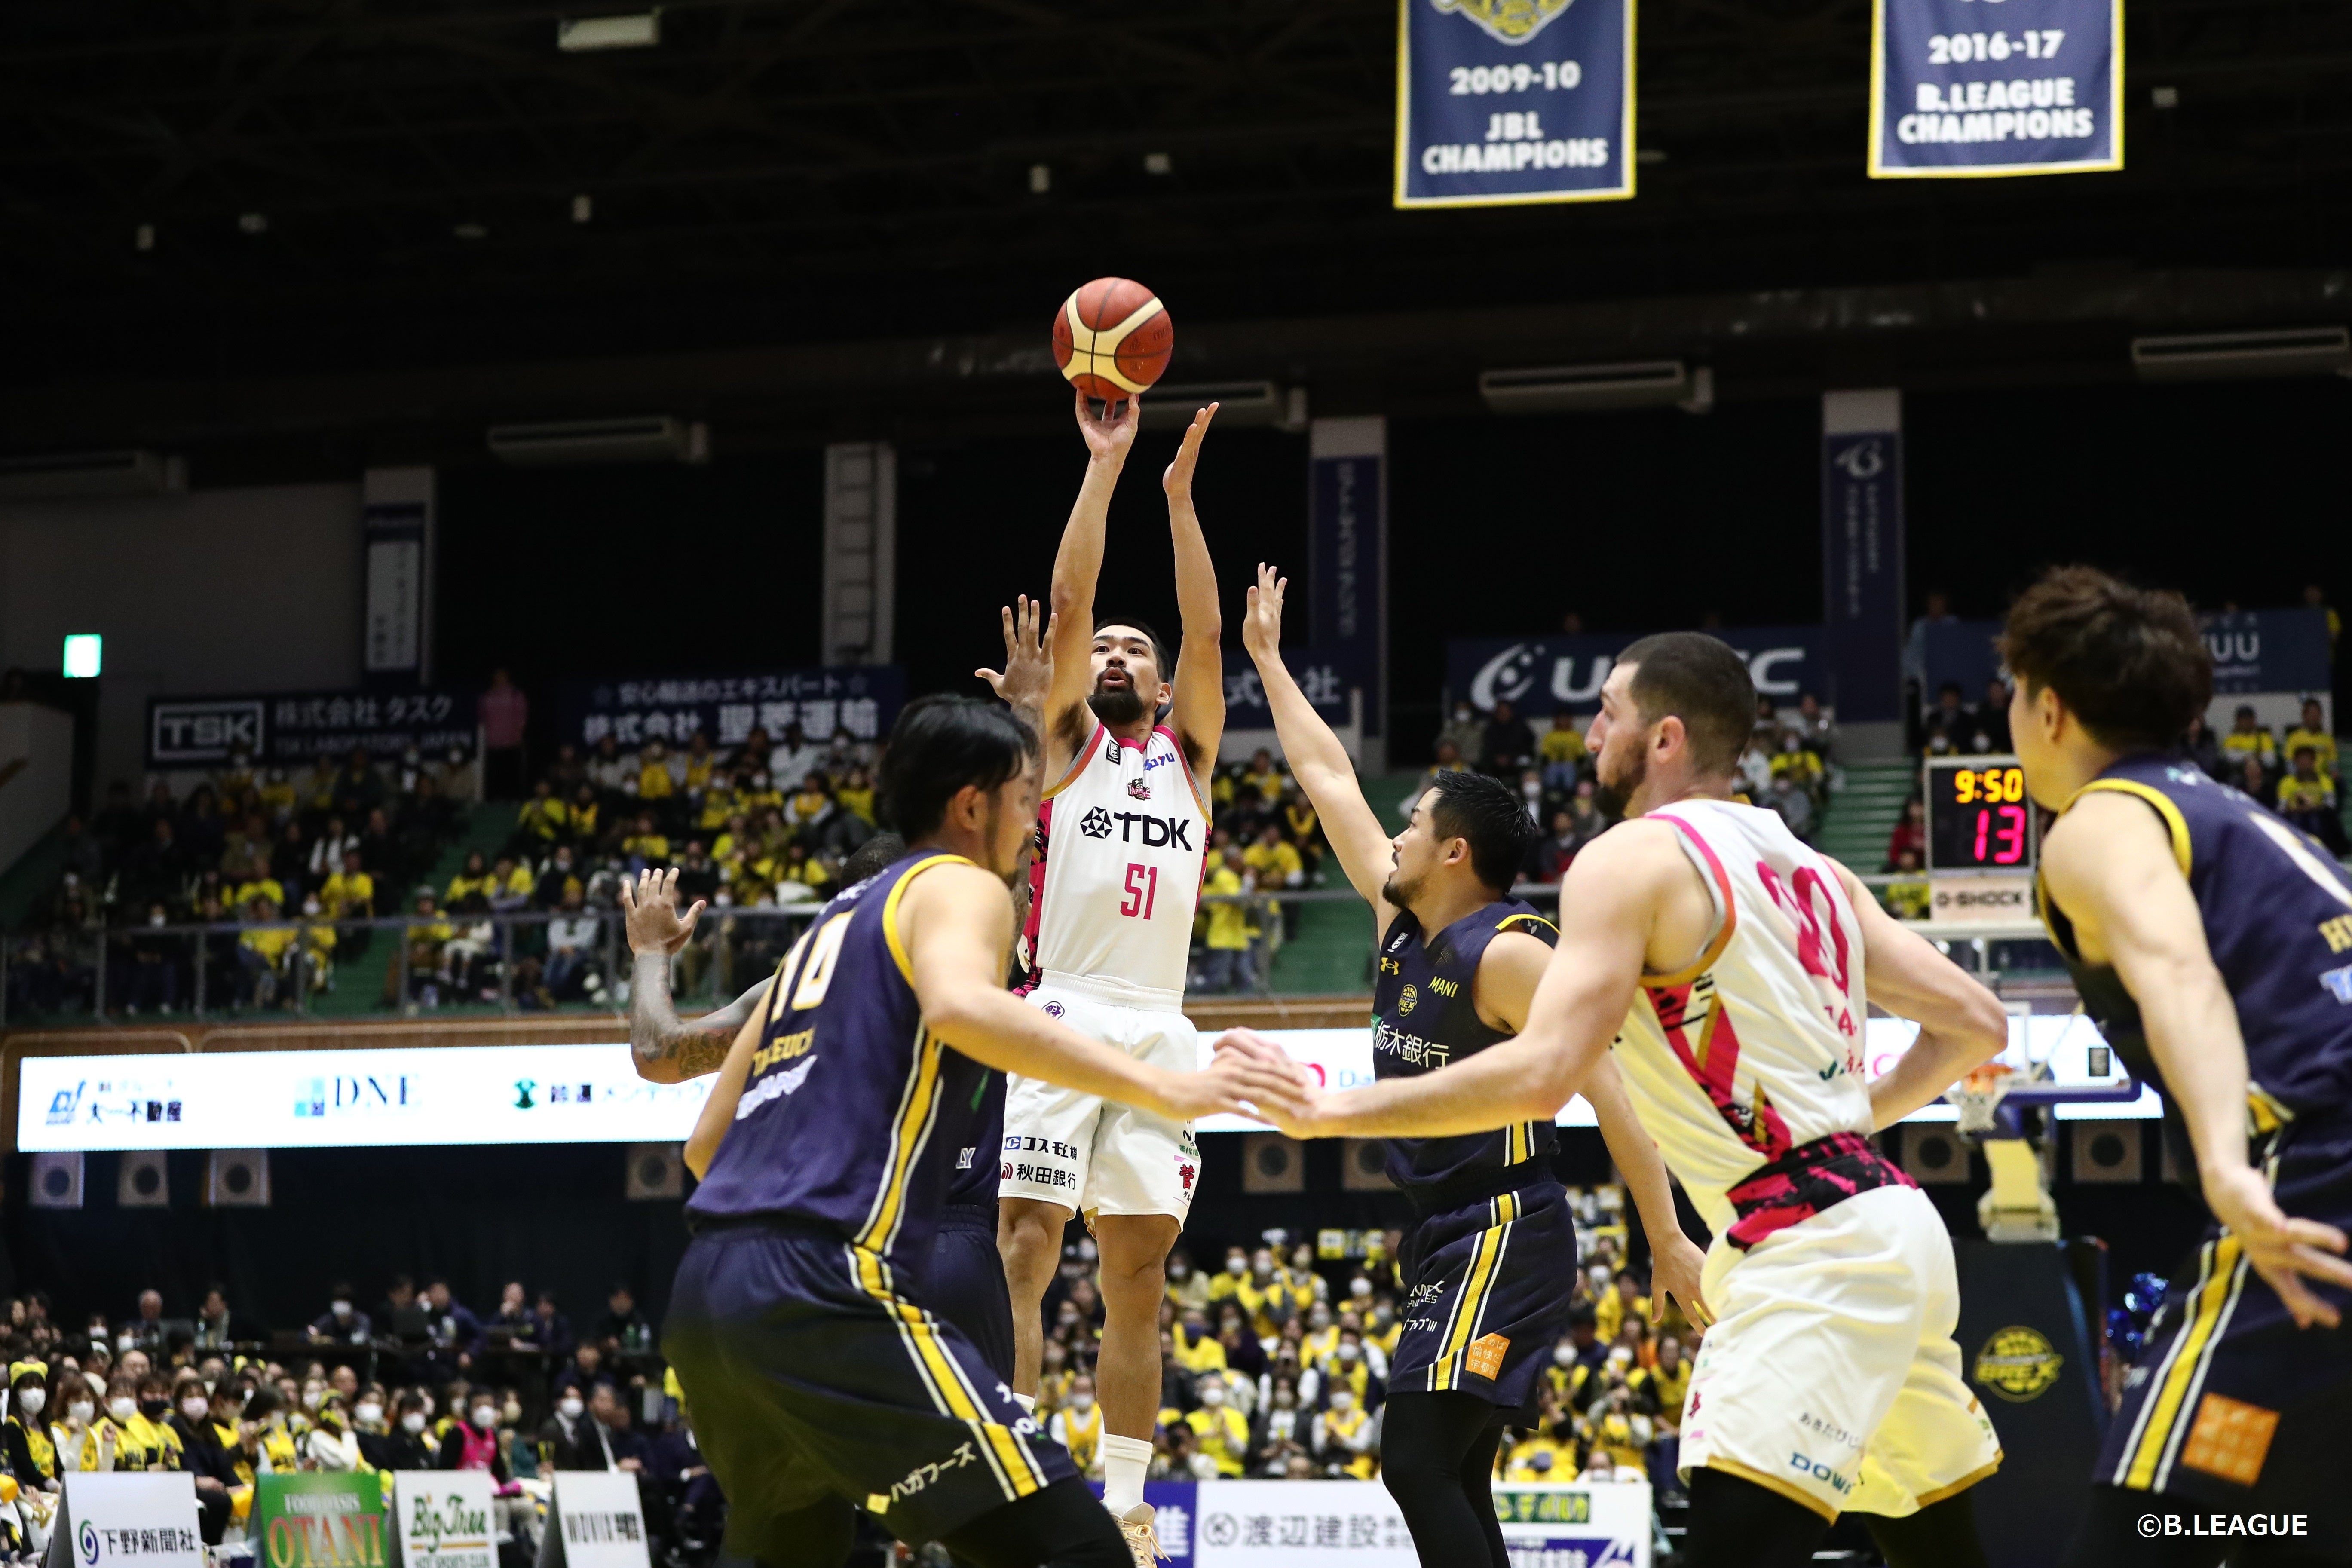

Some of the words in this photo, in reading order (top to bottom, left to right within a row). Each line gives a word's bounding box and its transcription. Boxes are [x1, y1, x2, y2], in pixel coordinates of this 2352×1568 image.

[1929, 30, 2064, 64] 2016-17
[1449, 61, 1581, 95] 2009-10
[1917, 79, 2075, 113] B.LEAGUE
[1486, 113, 1542, 141] JBL
[1897, 109, 2093, 143] CHAMPIONS
[1423, 139, 1608, 175] CHAMPIONS
[161, 715, 254, 747] TSK
[1955, 768, 2023, 803] 9:50
[1113, 812, 1192, 851] TDK
[1974, 805, 2026, 864] 13
[1120, 862, 1158, 920] 51
[1428, 976, 1459, 998] MANI
[1375, 1021, 1450, 1070] 栃木銀行
[1017, 1164, 1076, 1190] 秋田銀行
[99, 1528, 196, 1554] 下野新聞社
[268, 1514, 385, 1568] OTANI
[1244, 1513, 1379, 1548] 渡辺建設
